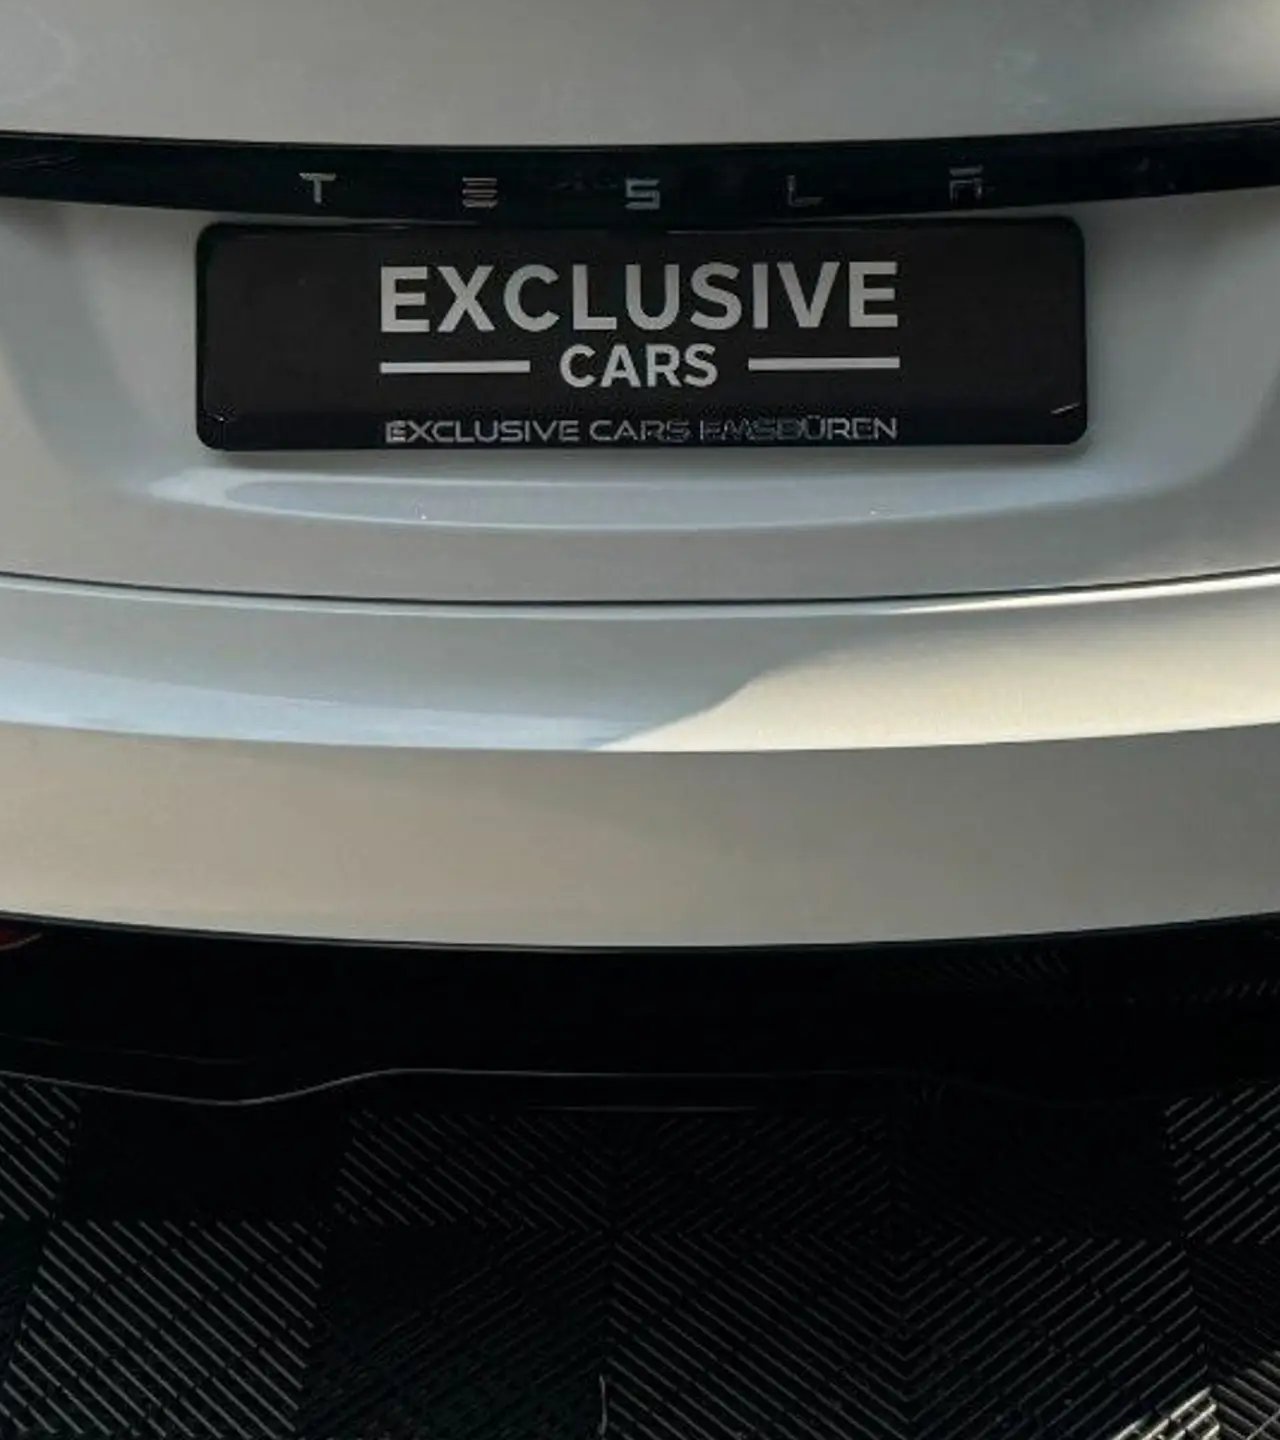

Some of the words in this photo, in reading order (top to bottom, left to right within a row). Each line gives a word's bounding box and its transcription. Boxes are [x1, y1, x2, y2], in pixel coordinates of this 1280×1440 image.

[299, 167, 984, 210] TESLA
[380, 261, 899, 333] EXCLUSIVE
[560, 343, 719, 389] CARS
[384, 419, 581, 443] EXCLUSIVE
[589, 419, 690, 443] CARS
